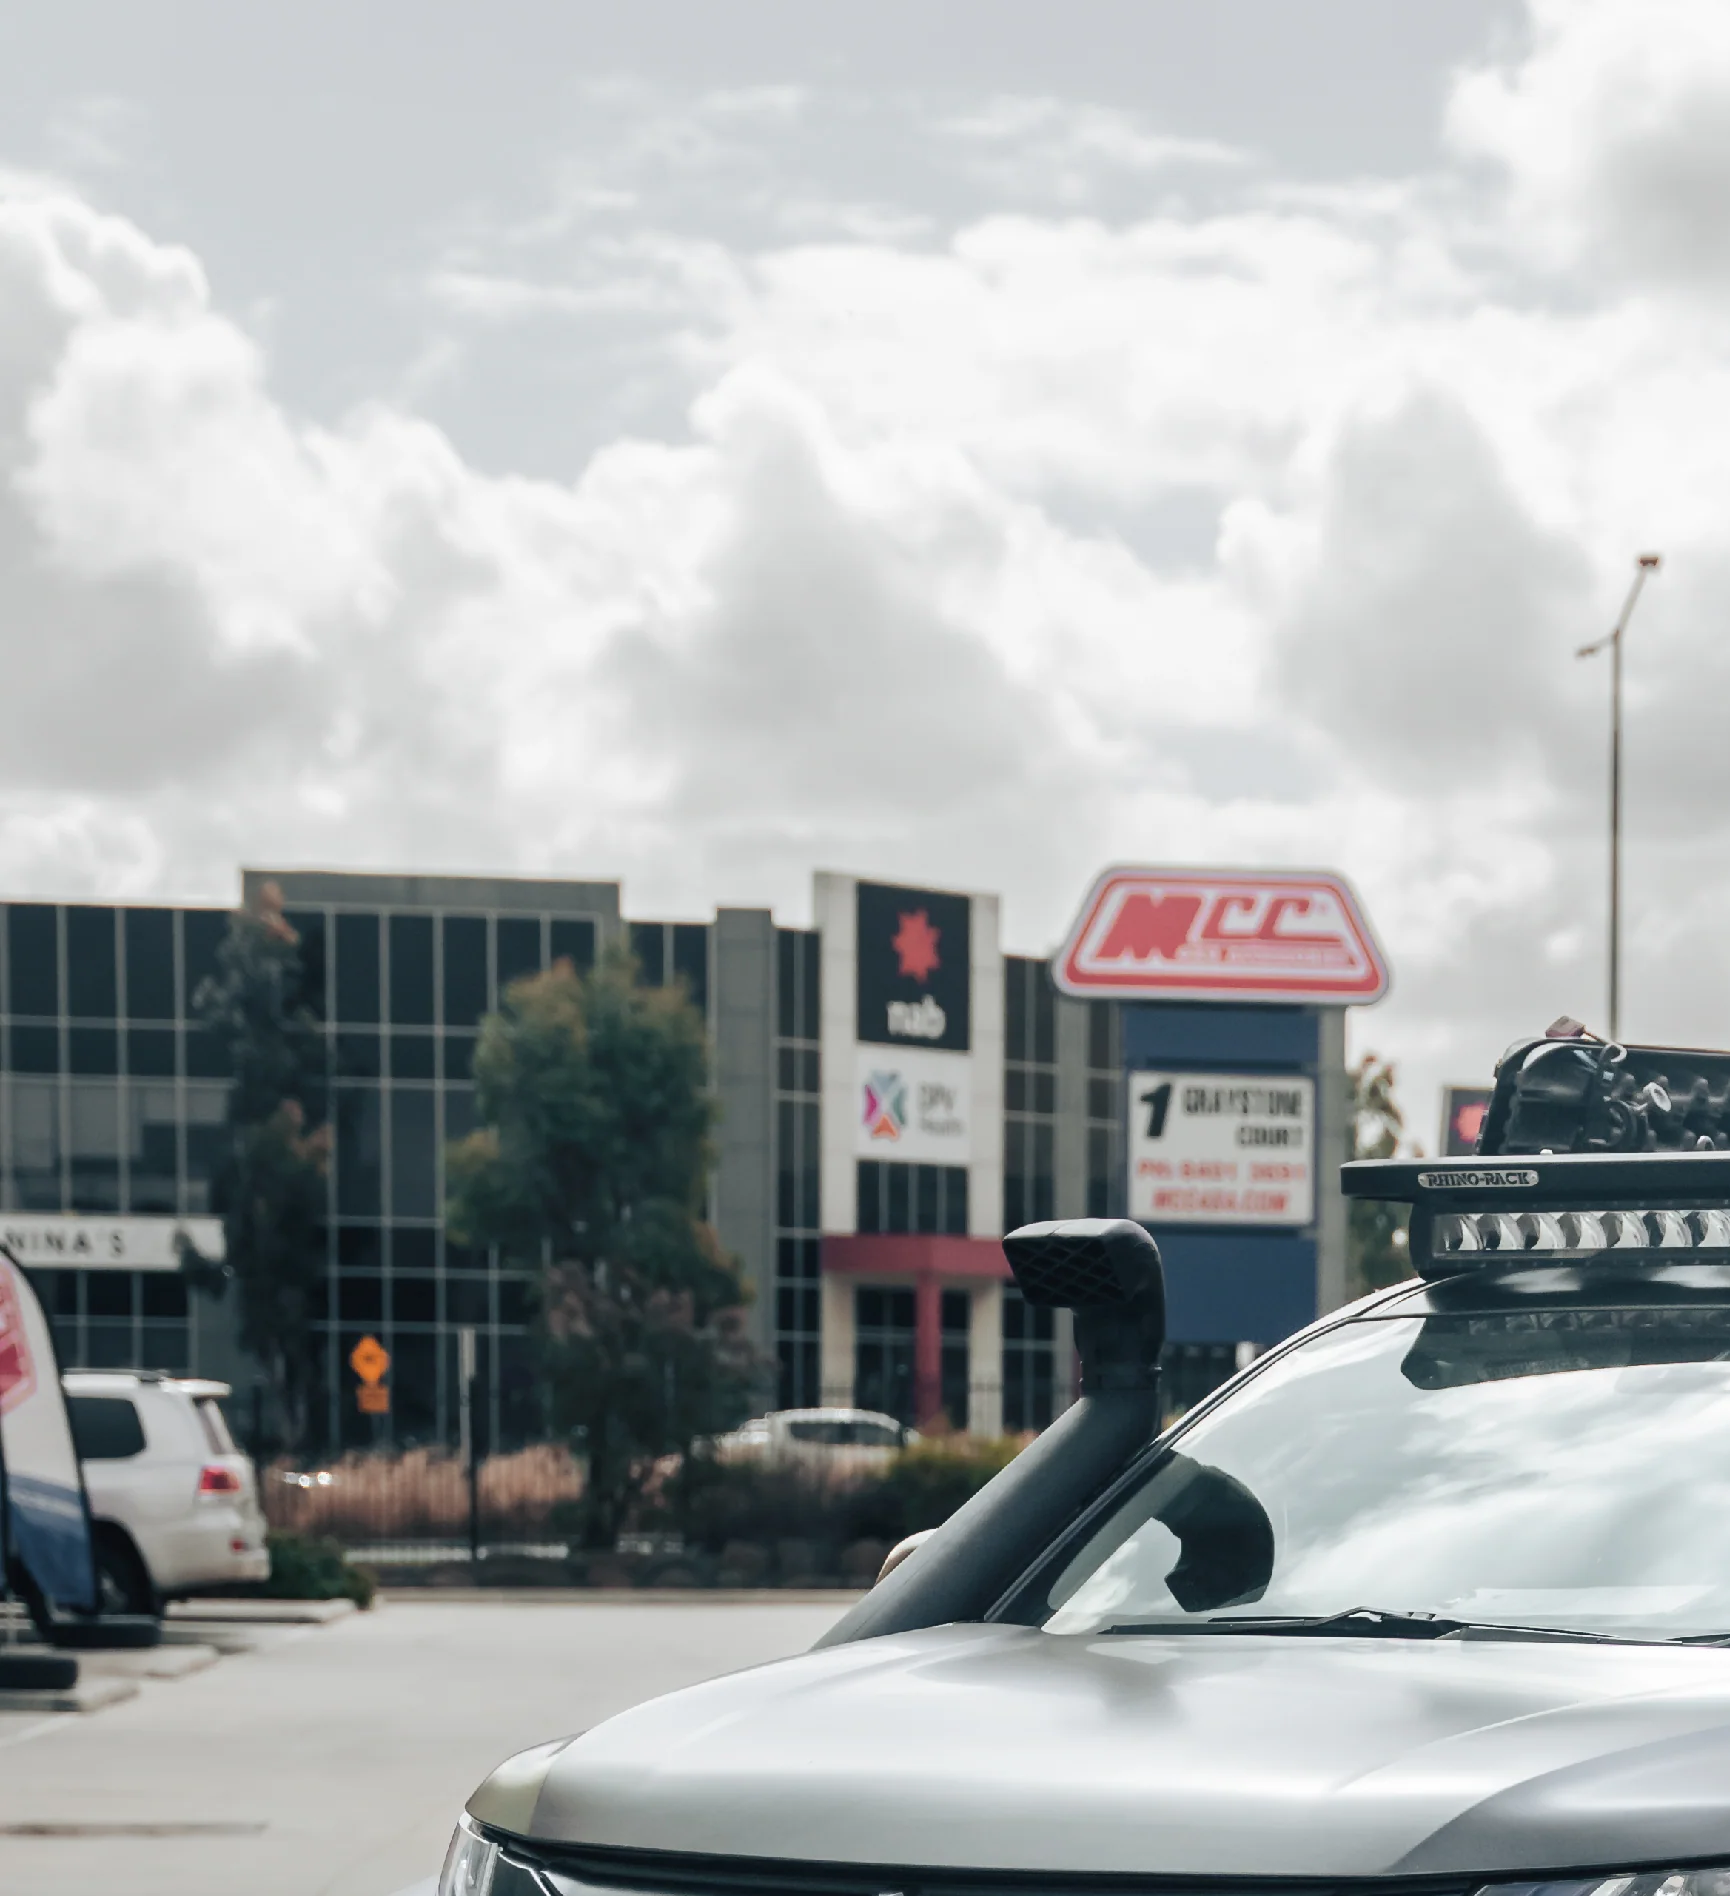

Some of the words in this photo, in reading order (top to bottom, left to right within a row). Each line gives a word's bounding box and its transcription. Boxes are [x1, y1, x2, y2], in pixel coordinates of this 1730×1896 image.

[1096, 893, 1342, 960] MCC
[887, 994, 946, 1039] nab
[1139, 1083, 1173, 1138] 1
[1427, 1172, 1530, 1187] RHINO-RACK
